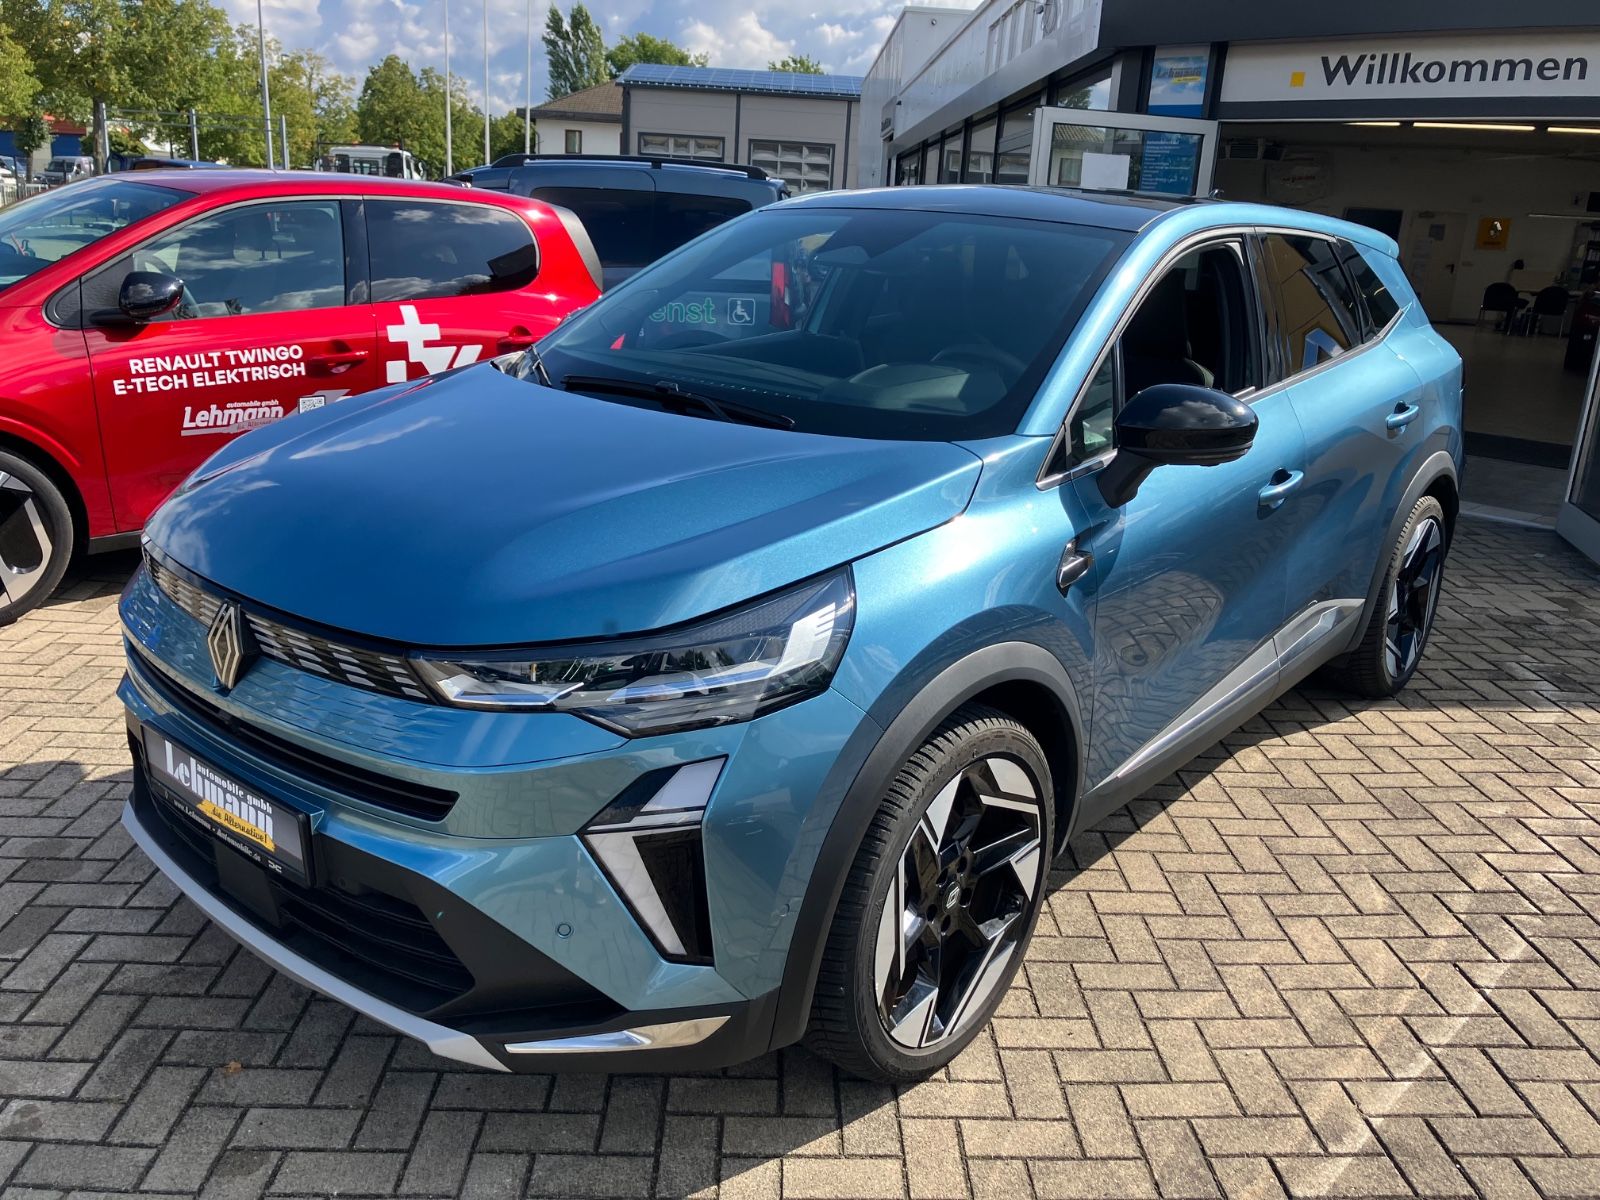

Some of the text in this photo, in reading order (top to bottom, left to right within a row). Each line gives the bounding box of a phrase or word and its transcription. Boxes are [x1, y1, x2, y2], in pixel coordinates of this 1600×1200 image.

[1320, 52, 1589, 86] Willkommen
[129, 345, 303, 375] RENAULT TWINGO
[113, 362, 306, 395] E-TECH ELEKTRISCH
[183, 404, 284, 428] Lehmann
[226, 399, 279, 408] automobile gmbh
[165, 740, 274, 840] Lehmann
[196, 764, 272, 815] automobile gmbh
